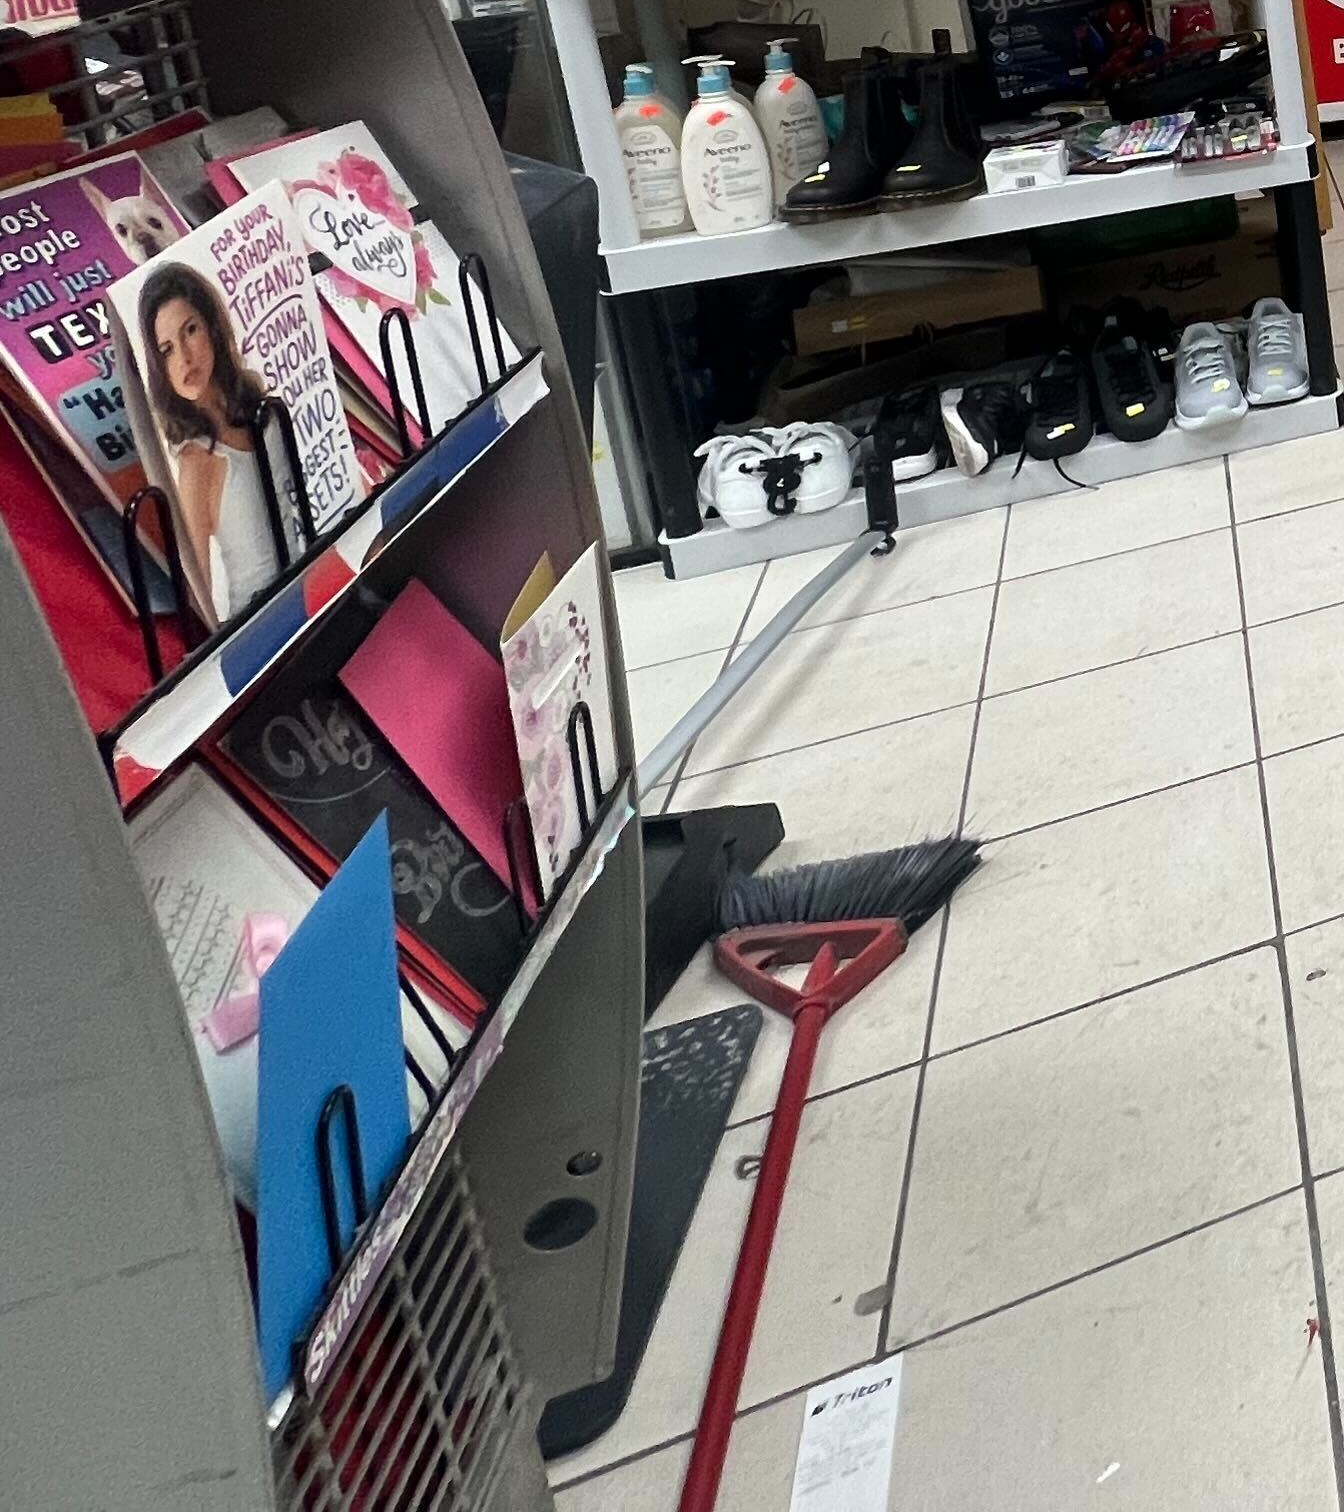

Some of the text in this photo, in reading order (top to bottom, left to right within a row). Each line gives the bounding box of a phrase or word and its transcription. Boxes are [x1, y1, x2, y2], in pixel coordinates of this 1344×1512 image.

[704, 143, 752, 157] Aveeno
[210, 204, 274, 263] FOR YOUR
[310, 201, 387, 250] Love
[217, 218, 291, 297] BIRTHDAY,
[351, 231, 408, 278] always
[1, 258, 113, 321] will just
[29, 301, 110, 358] TEX
[256, 303, 308, 359] GONNA
[263, 321, 317, 392] SHOW
[282, 356, 328, 408] OU HER
[293, 387, 337, 446] TWO
[832, 1376, 893, 1409] Triton
